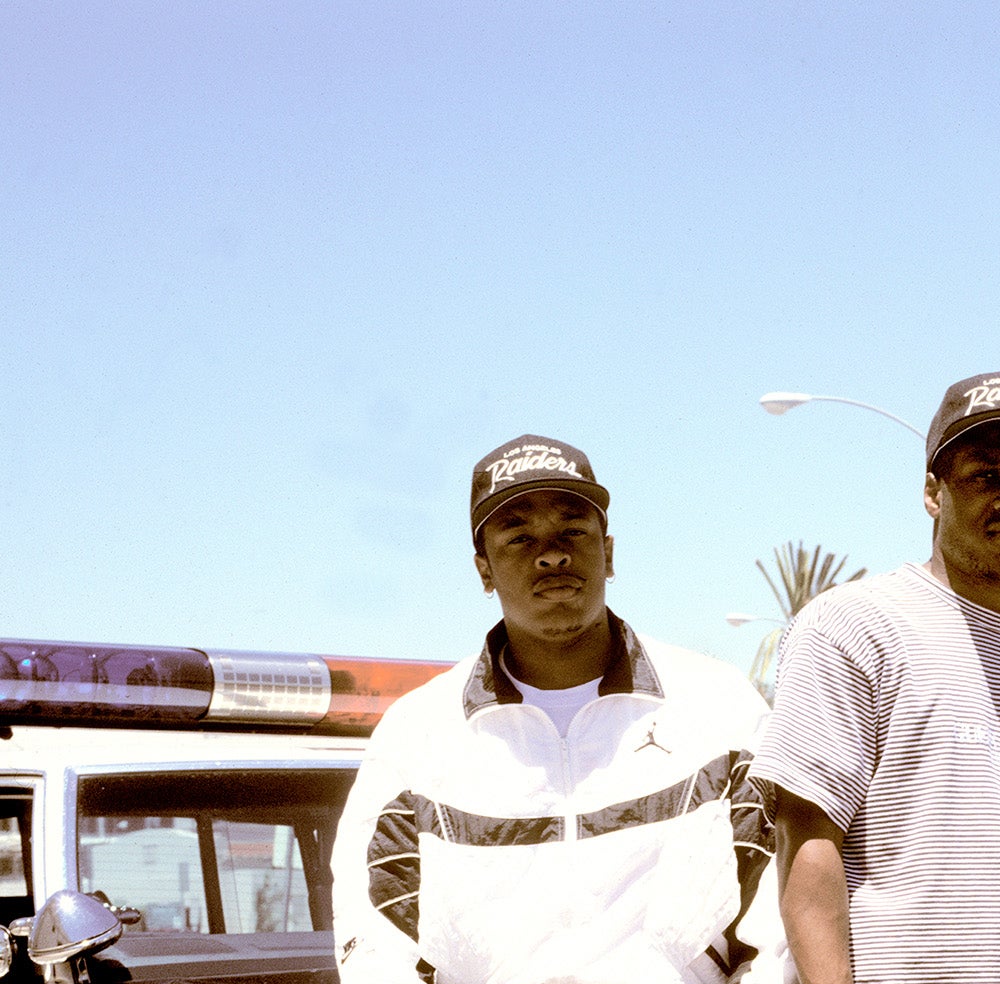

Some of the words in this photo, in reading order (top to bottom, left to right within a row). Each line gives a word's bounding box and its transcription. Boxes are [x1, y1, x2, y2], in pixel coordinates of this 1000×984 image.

[503, 447, 520, 458] LOS
[522, 444, 561, 455] ANGELES
[485, 451, 582, 494] Raiders
